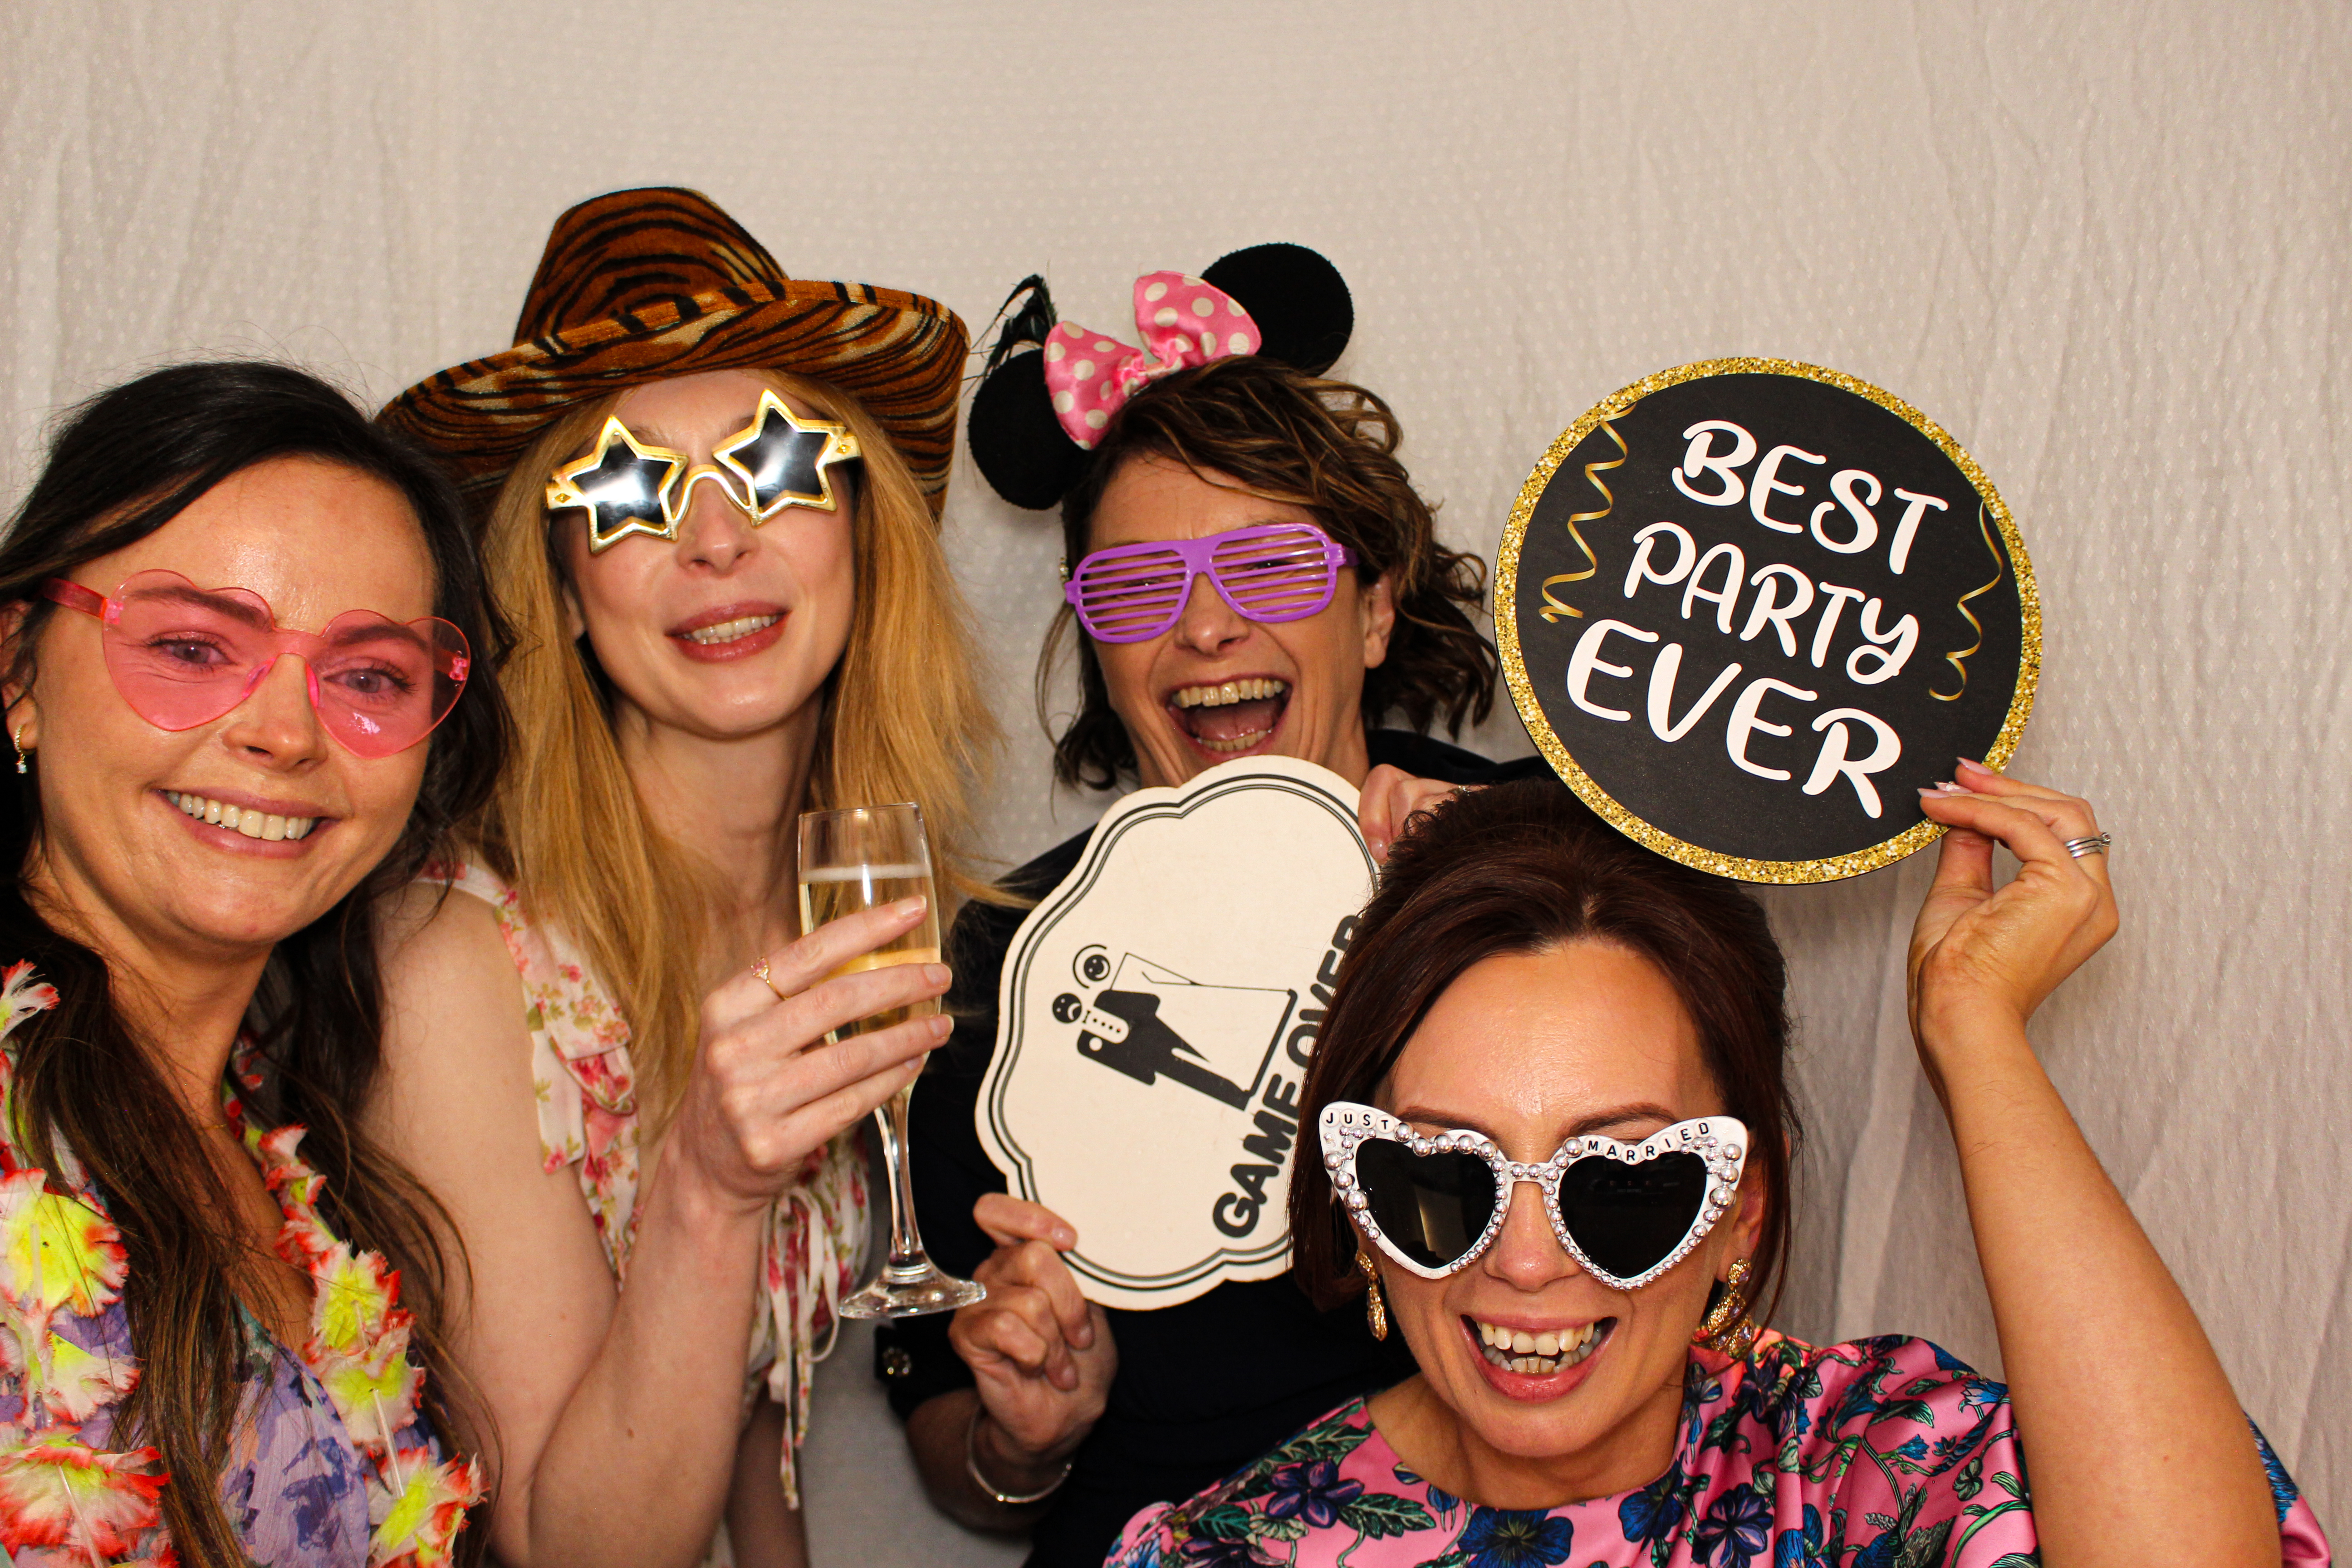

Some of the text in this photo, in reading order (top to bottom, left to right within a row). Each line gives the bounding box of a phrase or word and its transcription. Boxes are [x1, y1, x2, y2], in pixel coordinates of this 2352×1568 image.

[1671, 420, 1948, 575] BEST
[1623, 521, 1920, 685] PARTY
[1566, 618, 1901, 818] EVER
[1212, 1073, 1300, 1238] GAME
[1325, 1112, 1710, 1161] JUST MARRIED
